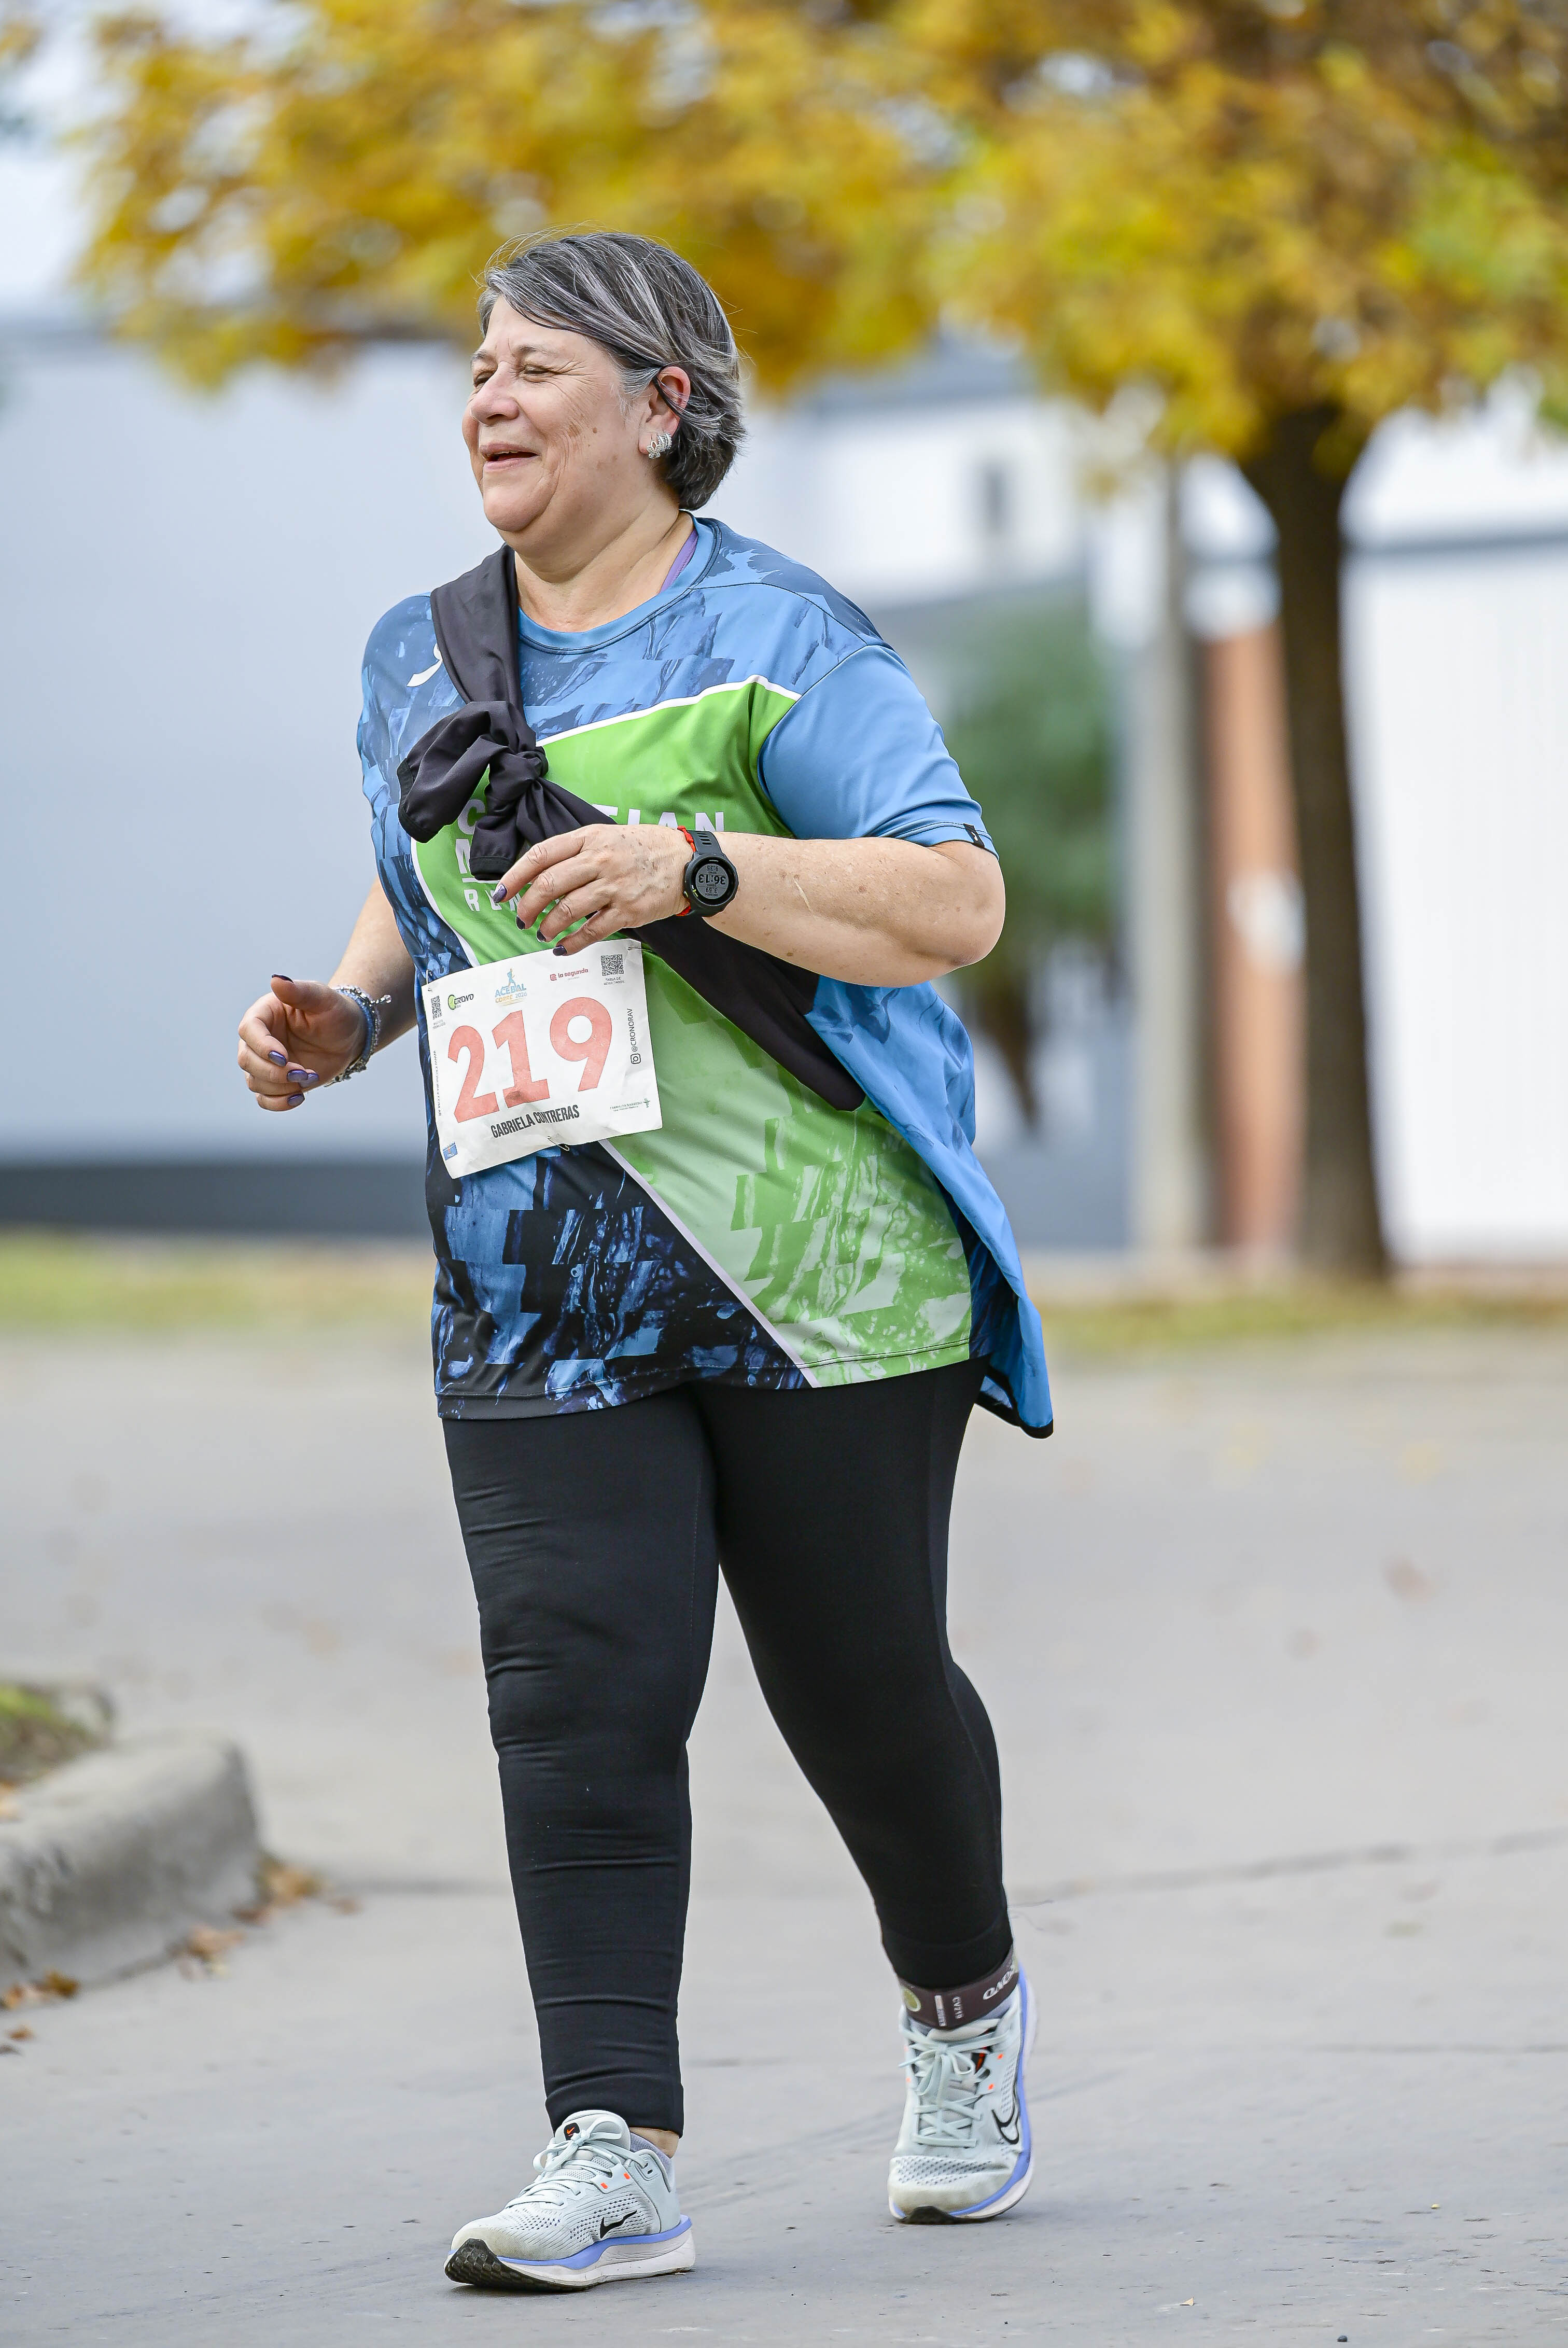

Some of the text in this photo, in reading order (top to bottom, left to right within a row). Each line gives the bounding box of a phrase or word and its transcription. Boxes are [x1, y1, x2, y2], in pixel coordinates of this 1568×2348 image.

[698, 874, 726, 885] 36:13
[495, 984, 527, 997] ACEBAL
[495, 994, 513, 1003] CORRE
[627, 1009, 638, 1053] @CRONORAV
[447, 997, 612, 1123] 219
[491, 1105, 580, 1138] GABRIELA CONTRERAS
